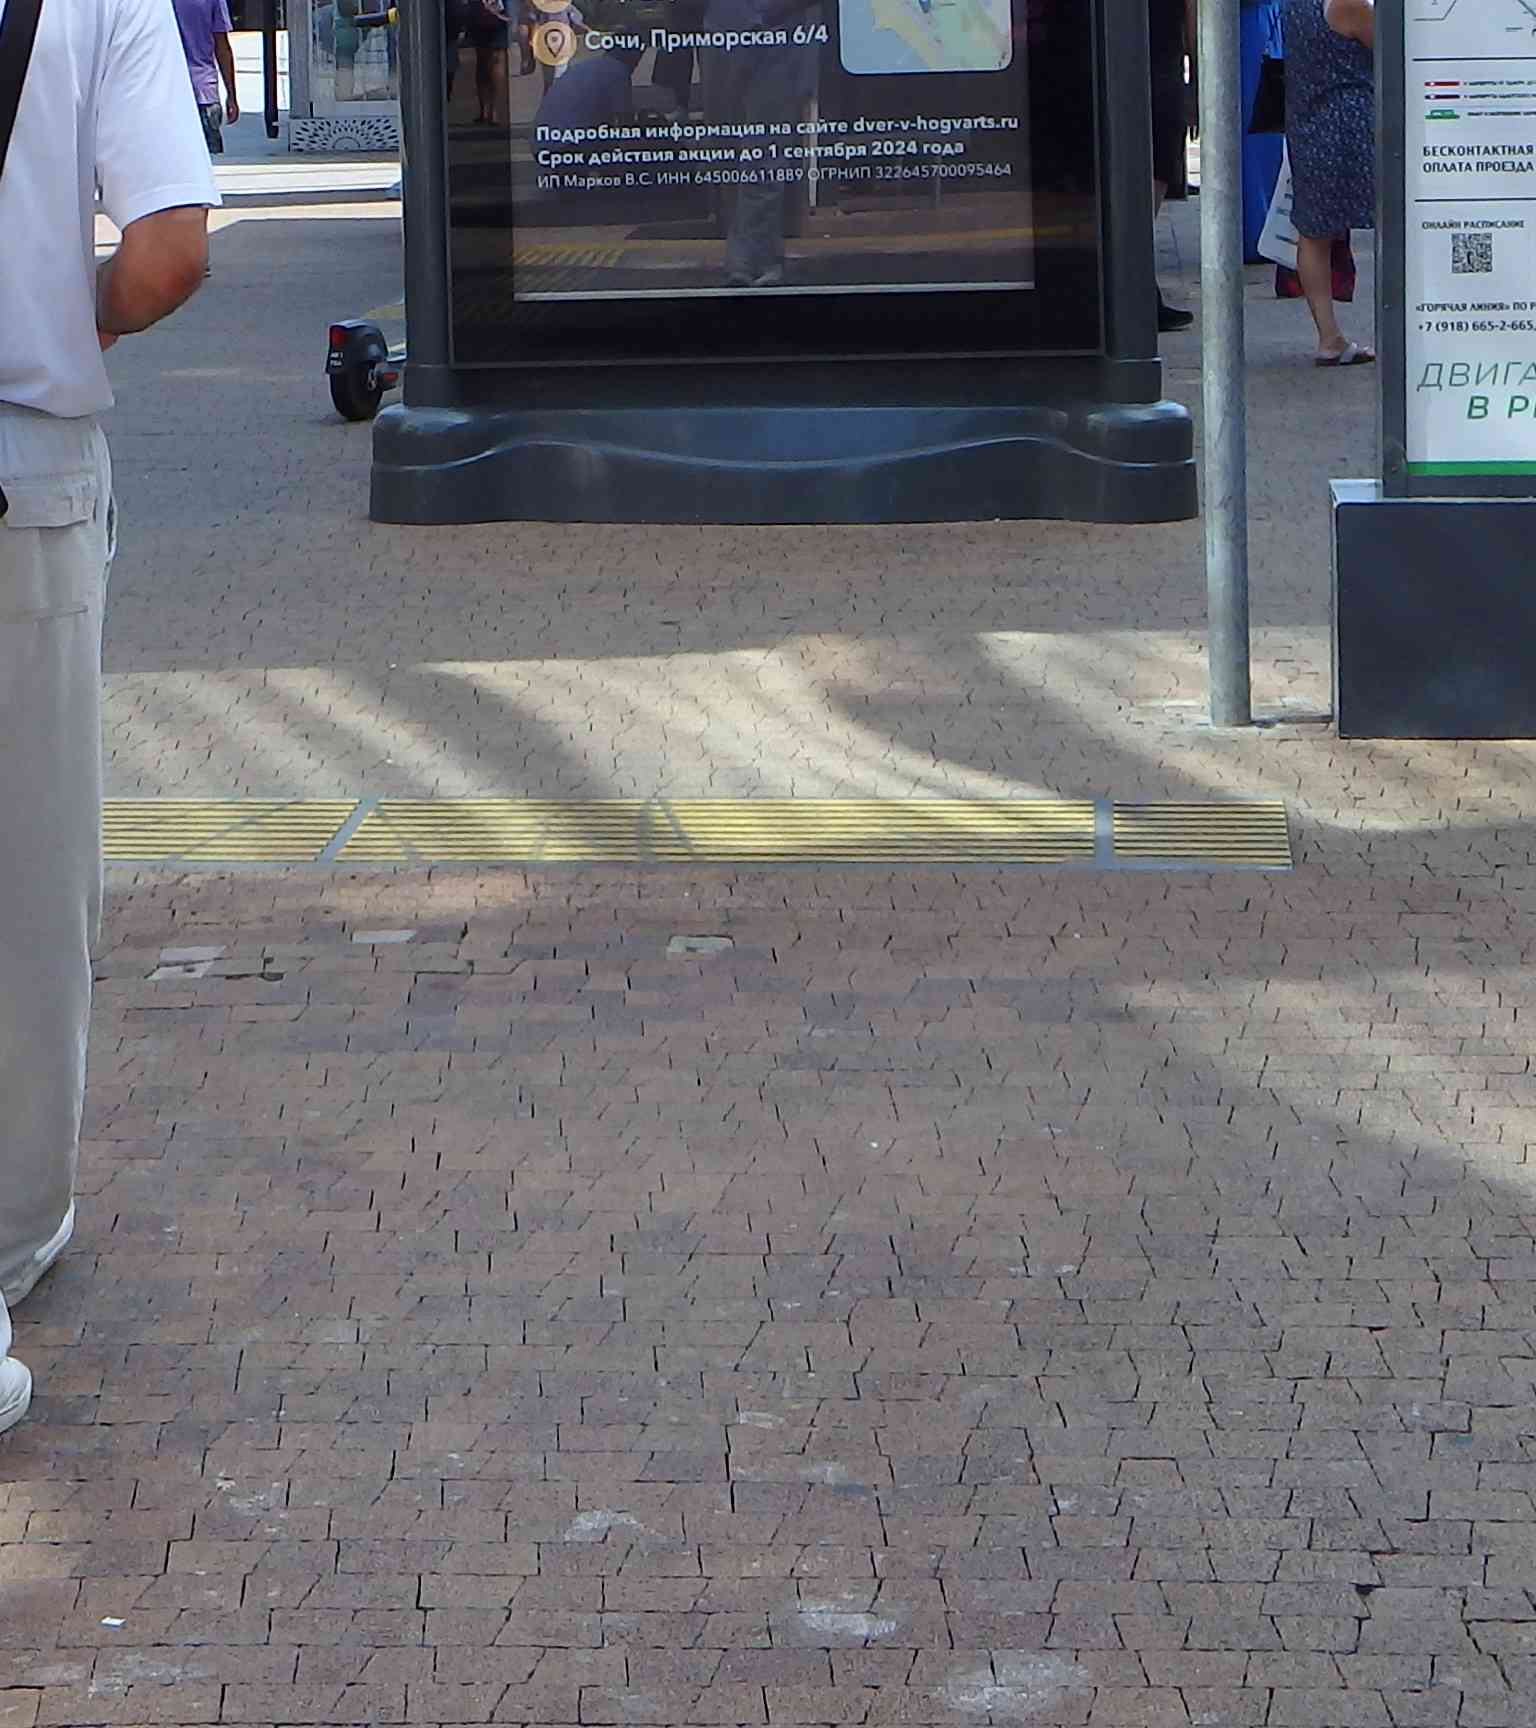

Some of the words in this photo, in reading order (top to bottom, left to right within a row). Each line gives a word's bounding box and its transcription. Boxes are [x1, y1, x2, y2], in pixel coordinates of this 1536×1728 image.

[584, 30, 645, 51] Сочи,
[651, 27, 787, 53] Приморская
[793, 24, 829, 45] 6/4
[536, 124, 641, 145] Подробная
[645, 122, 765, 141] информация
[769, 122, 791, 135] на
[796, 119, 853, 135] сайте
[853, 115, 1018, 134] dver-v-hogvarts.ru
[537, 150, 585, 168] Срок
[588, 148, 674, 166] действия
[678, 148, 735, 162] акции
[739, 148, 763, 162] до
[768, 144, 778, 159] 1
[783, 142, 866, 160] сентября
[871, 140, 918, 157] 2024
[922, 142, 965, 156] года
[1423, 144, 1535, 157] БЕСКОНТАКТНАЯ
[537, 174, 561, 189] ИП
[564, 174, 621, 190] Марков
[657, 171, 691, 185] ИНН
[694, 168, 804, 185] 645006611889
[807, 165, 872, 182] ОГРНИП
[875, 162, 1012, 179] 322645700095464
[1423, 161, 1473, 173] ОПЛАТА
[1513, 301, 1528, 311] ПО
[1435, 320, 1469, 333] (918)
[1466, 394, 1490, 420] В
